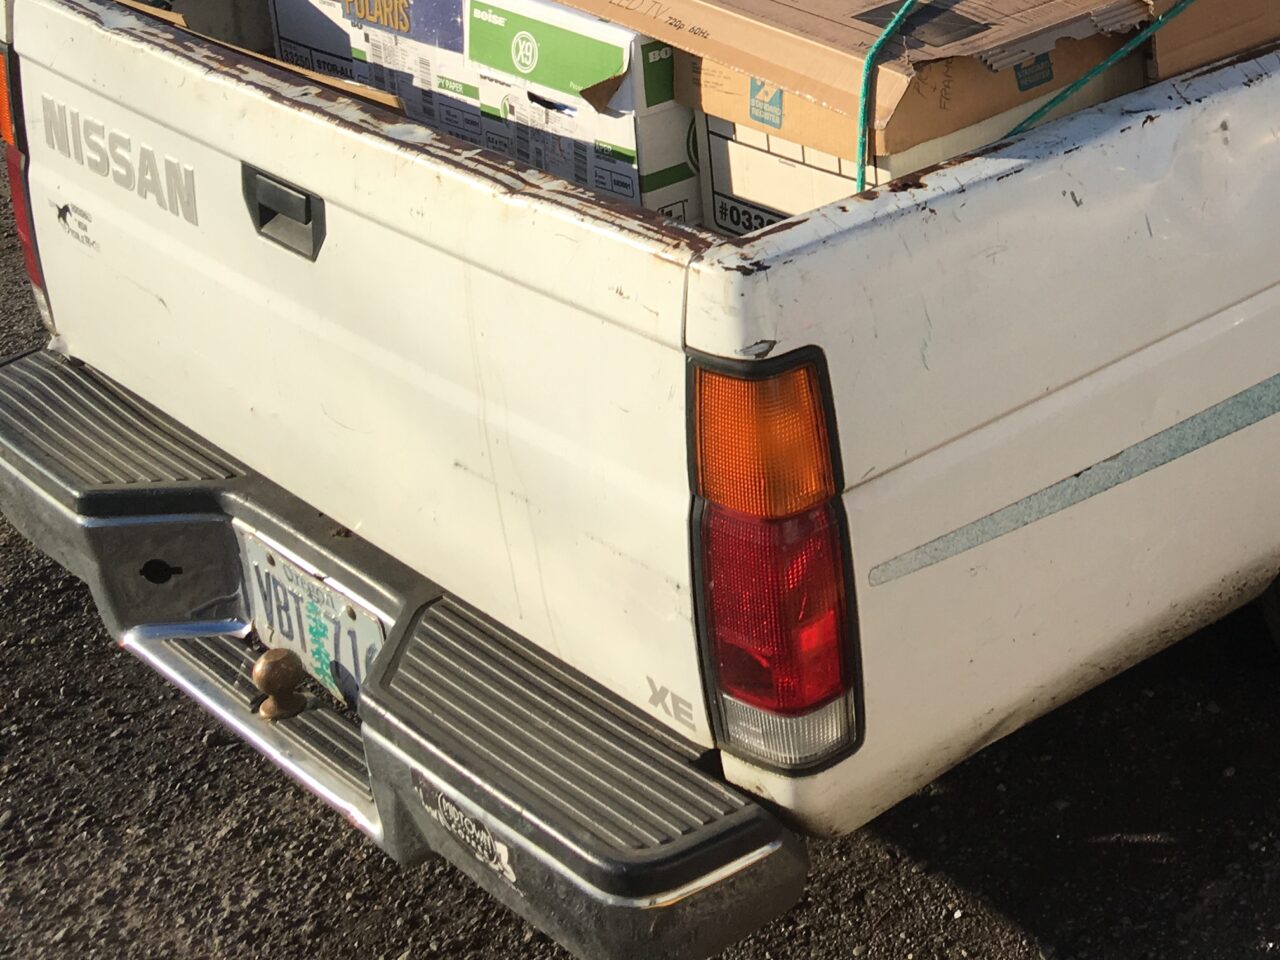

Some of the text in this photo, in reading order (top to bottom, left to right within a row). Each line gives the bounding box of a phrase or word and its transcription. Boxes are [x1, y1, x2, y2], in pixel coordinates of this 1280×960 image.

[645, 0, 671, 20] TV
[664, 16, 685, 31] 720p
[688, 25, 710, 40] 60Hz
[648, 46, 672, 63] BO
[751, 107, 780, 125] REGISTER
[41, 91, 199, 227] NISSAN
[253, 561, 307, 653] VBT
[283, 564, 337, 613] Oregon
[646, 675, 697, 732] XE
